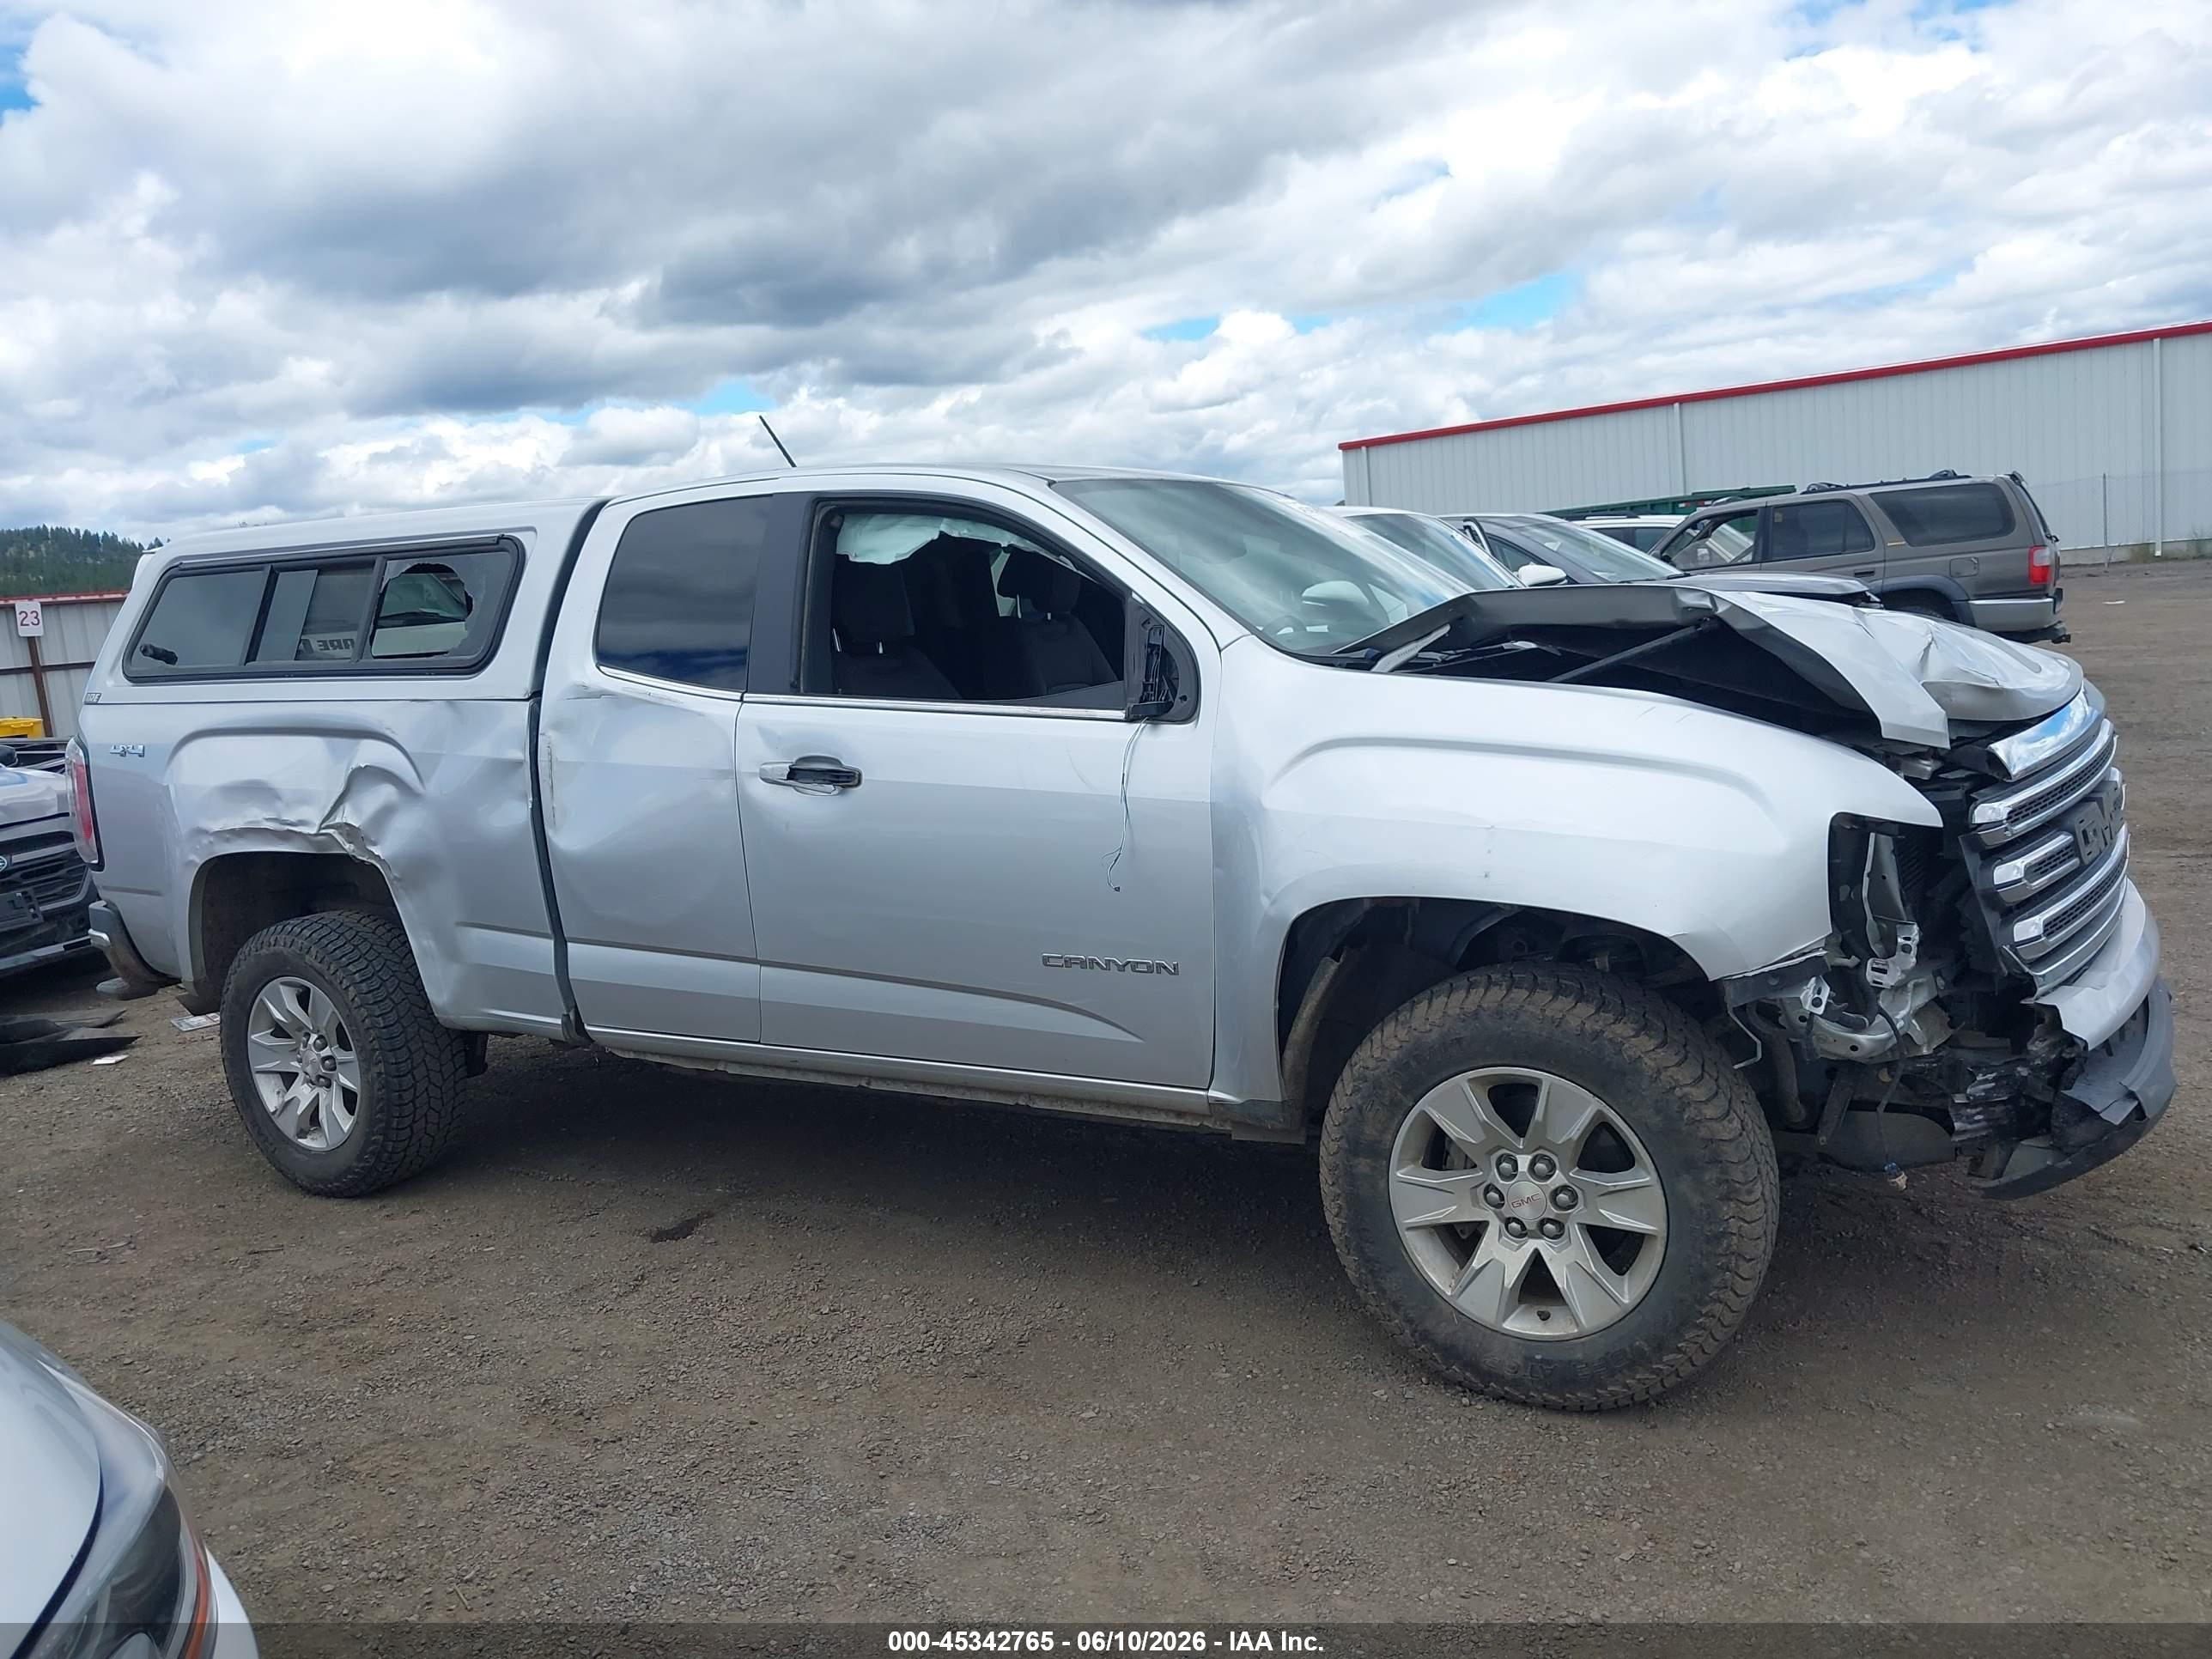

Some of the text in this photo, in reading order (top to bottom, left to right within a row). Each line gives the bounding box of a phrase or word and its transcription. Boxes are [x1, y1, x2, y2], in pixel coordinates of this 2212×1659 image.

[19, 610, 40, 627] 23
[1042, 952, 1180, 975] CANYON
[1511, 1193, 1540, 1208] GMC
